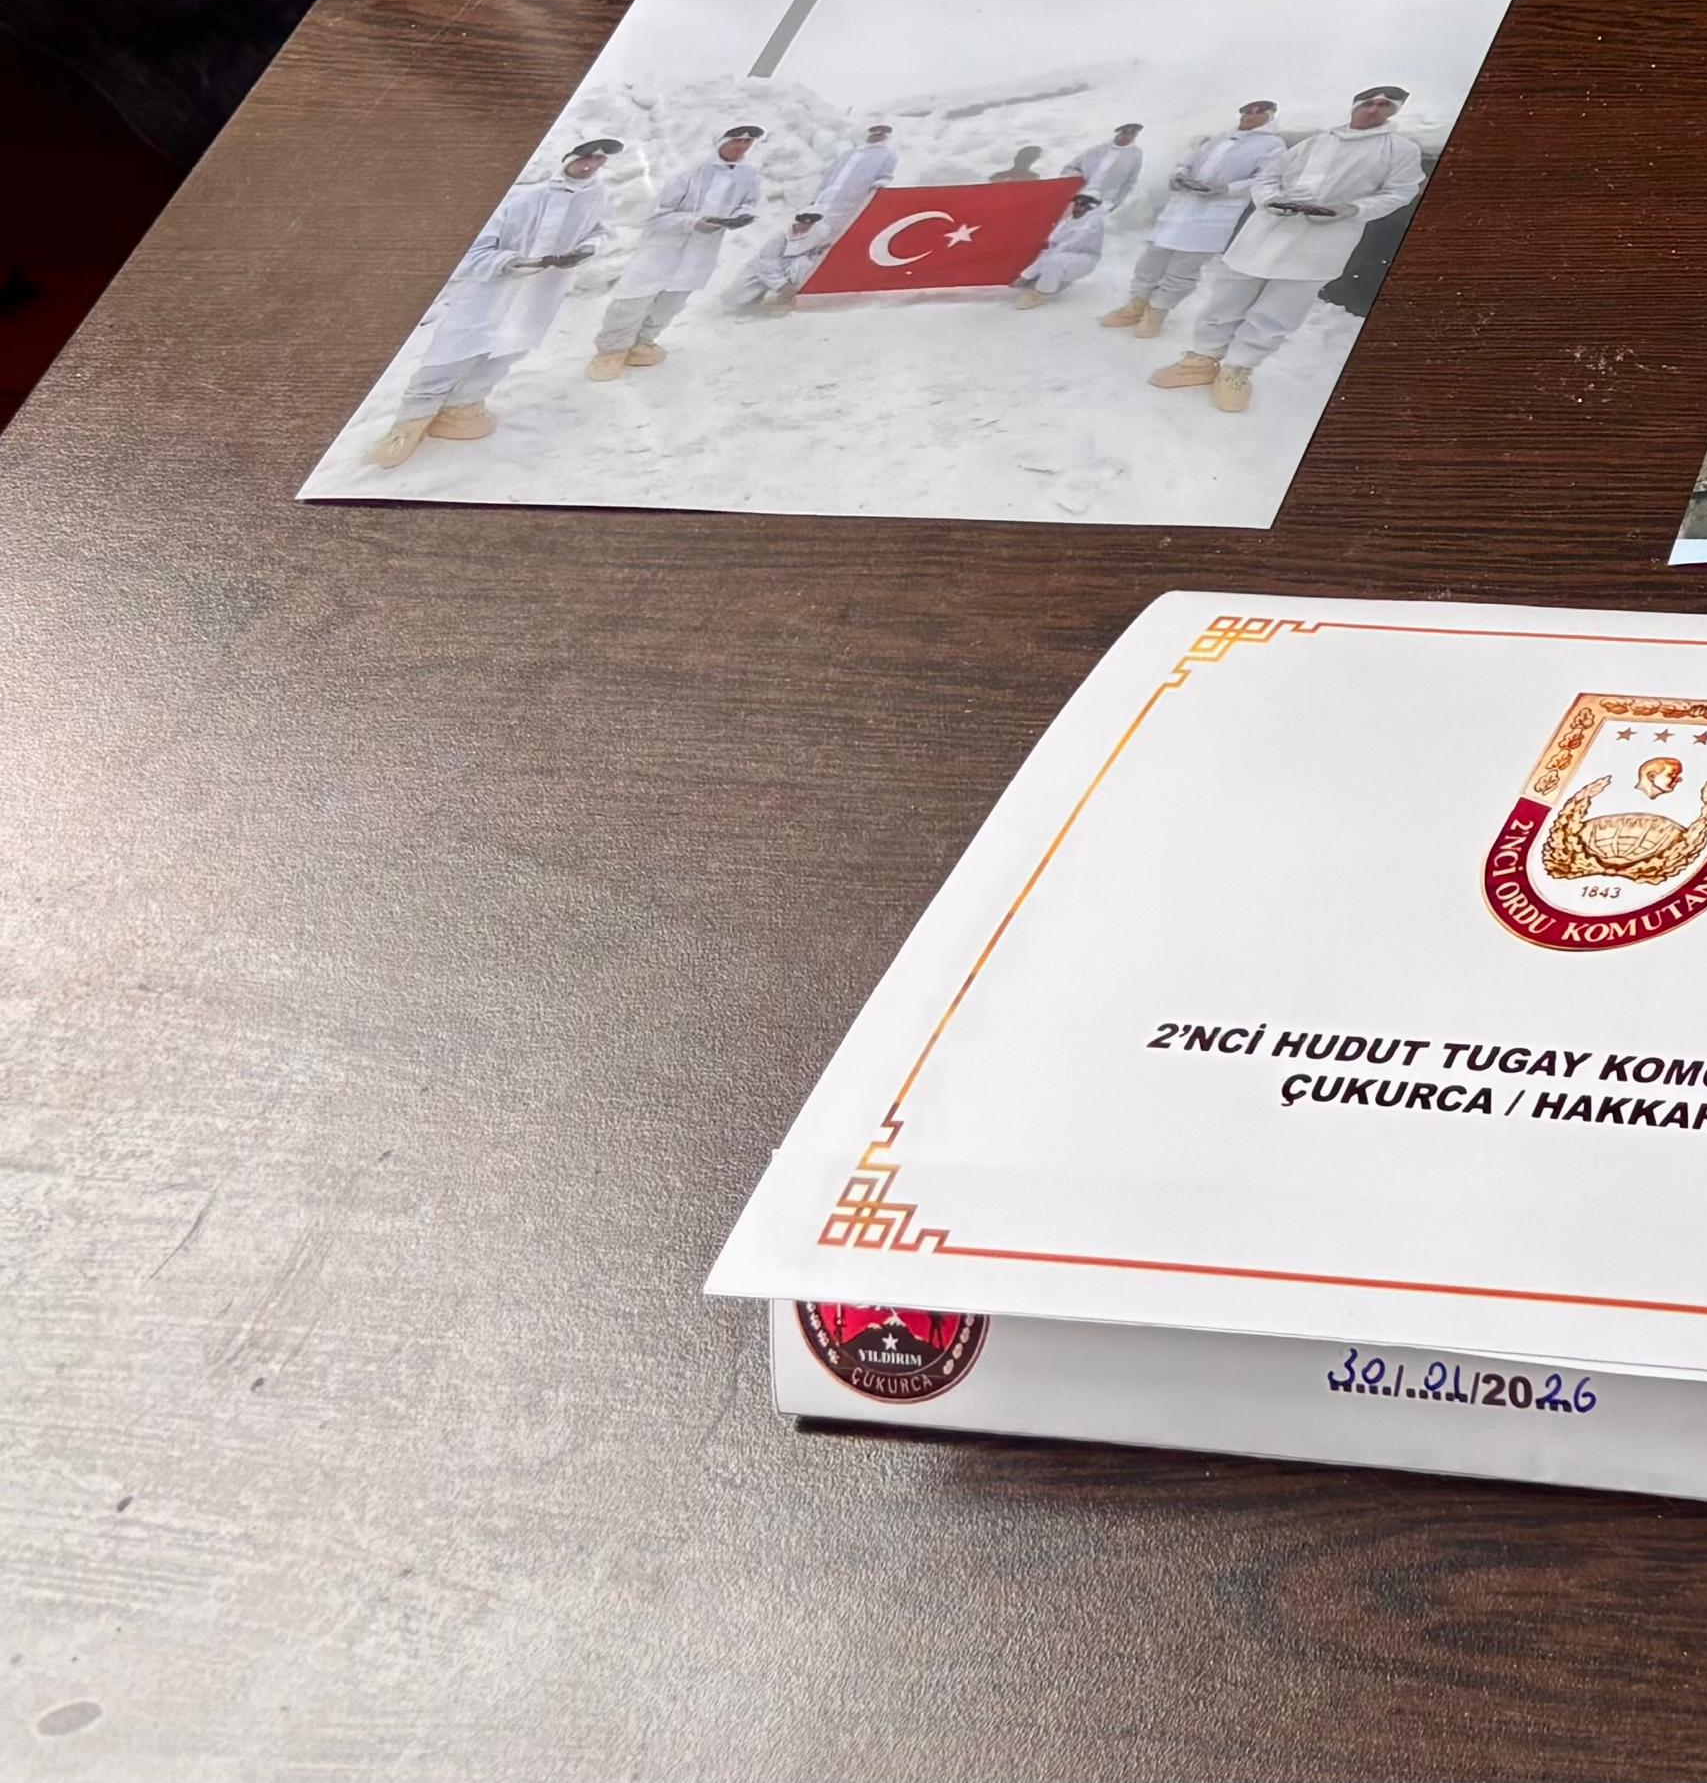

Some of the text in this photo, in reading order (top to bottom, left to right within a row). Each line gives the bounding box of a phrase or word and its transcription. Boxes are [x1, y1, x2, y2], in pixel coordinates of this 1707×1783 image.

[1493, 820, 1534, 878] 2'NCİ
[1495, 881, 1555, 934] ORDU
[1581, 886, 1622, 899] 1843
[1146, 1023, 1267, 1058] 2'NCİ
[1271, 1032, 1430, 1070] HUDUT
[1442, 1042, 1591, 1083] TUGAY
[1281, 1073, 1494, 1118] ÇUKURCA
[858, 1348, 922, 1366] YILDIRIM
[851, 1368, 933, 1393] ÇUKURCA
